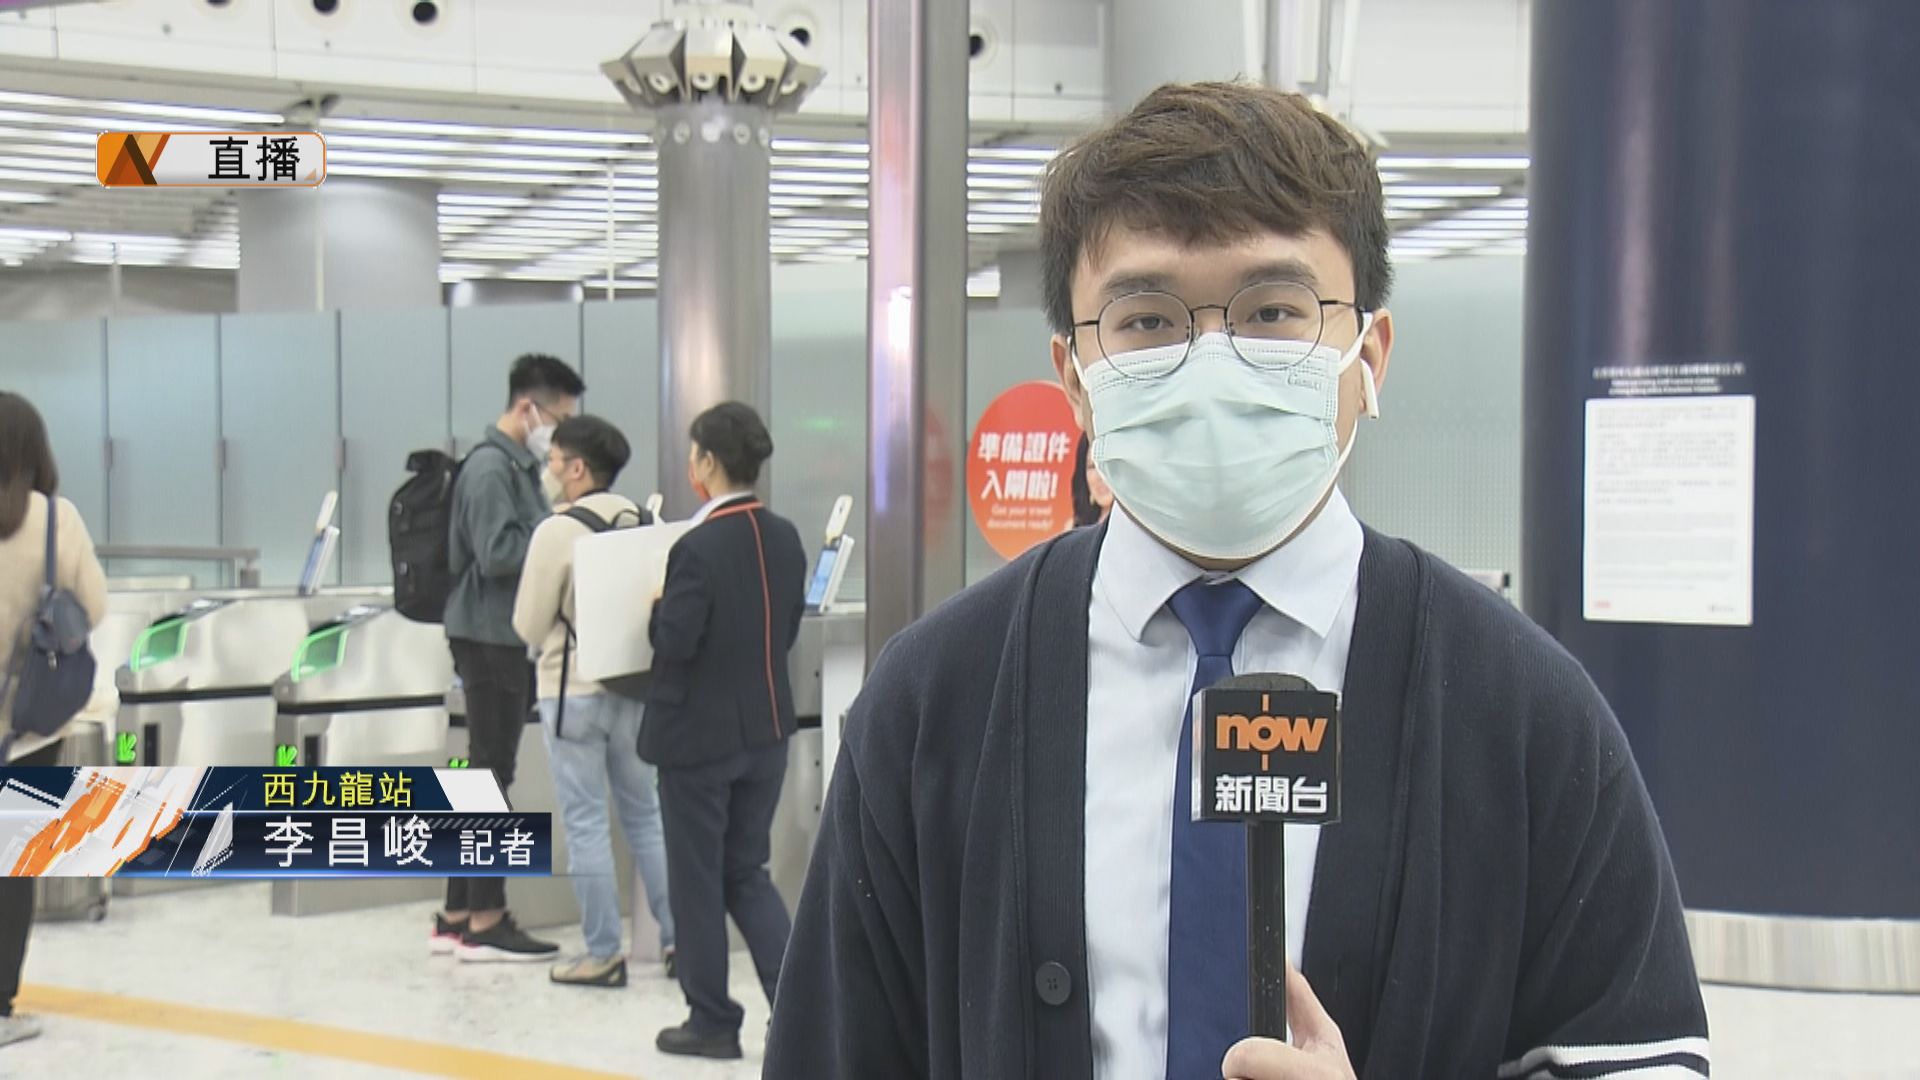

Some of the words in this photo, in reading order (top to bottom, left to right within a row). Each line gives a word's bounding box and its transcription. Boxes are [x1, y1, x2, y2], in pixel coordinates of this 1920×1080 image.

[1215, 714, 1328, 752] now
[1215, 774, 1328, 813] 新聞台
